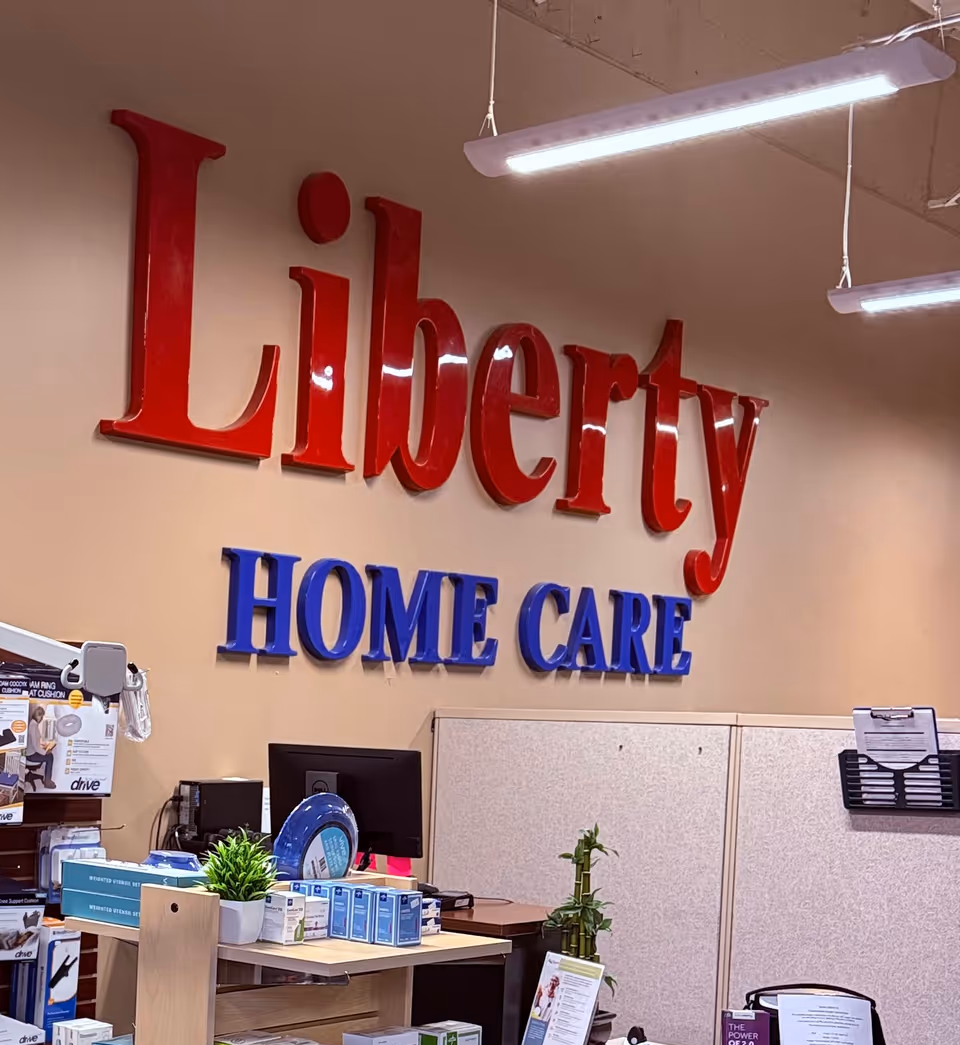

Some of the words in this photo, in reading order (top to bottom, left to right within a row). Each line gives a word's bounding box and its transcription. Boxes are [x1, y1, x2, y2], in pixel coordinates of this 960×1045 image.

[100, 109, 769, 596] Liberty
[217, 546, 499, 668] HOME
[519, 582, 693, 676] CARE
[38, 690, 65, 698] CUSHION
[70, 777, 100, 791] drive
[89, 875, 112, 884] WEIGHTED
[113, 879, 131, 887] UTENSIL
[89, 904, 112, 913] WEIGHTED
[15, 951, 32, 959] drive
[728, 1023, 745, 1031] THE
[19, 1034, 38, 1044] drive
[728, 1032, 759, 1040] POWER
